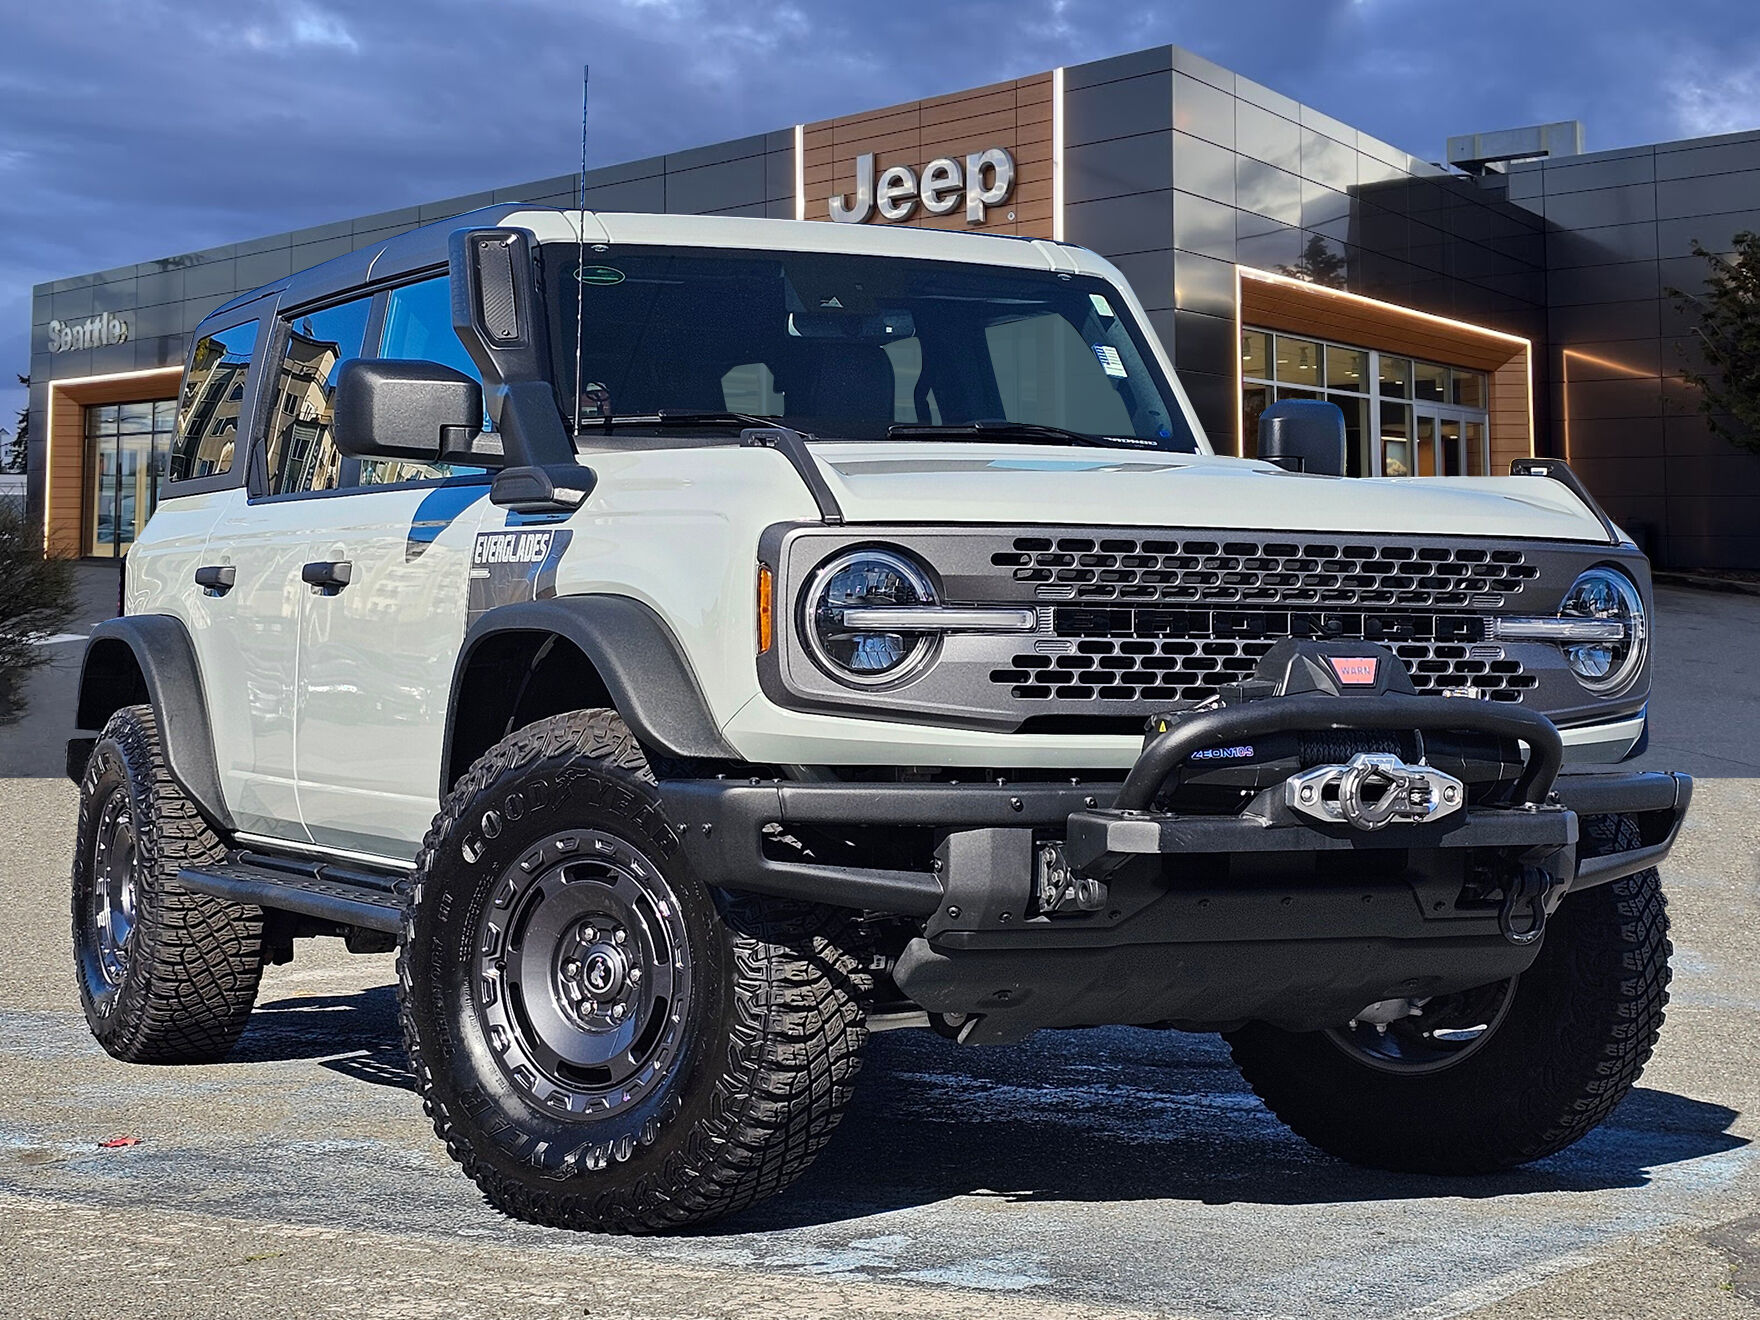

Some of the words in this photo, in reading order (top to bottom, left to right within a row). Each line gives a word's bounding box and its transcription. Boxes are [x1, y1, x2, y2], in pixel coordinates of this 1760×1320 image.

[828, 148, 1016, 226] Jeep
[48, 311, 127, 353] Seattle
[474, 533, 550, 563] EVERGLADES
[1341, 666, 1371, 676] WARN
[461, 768, 682, 864] GOODYEAR
